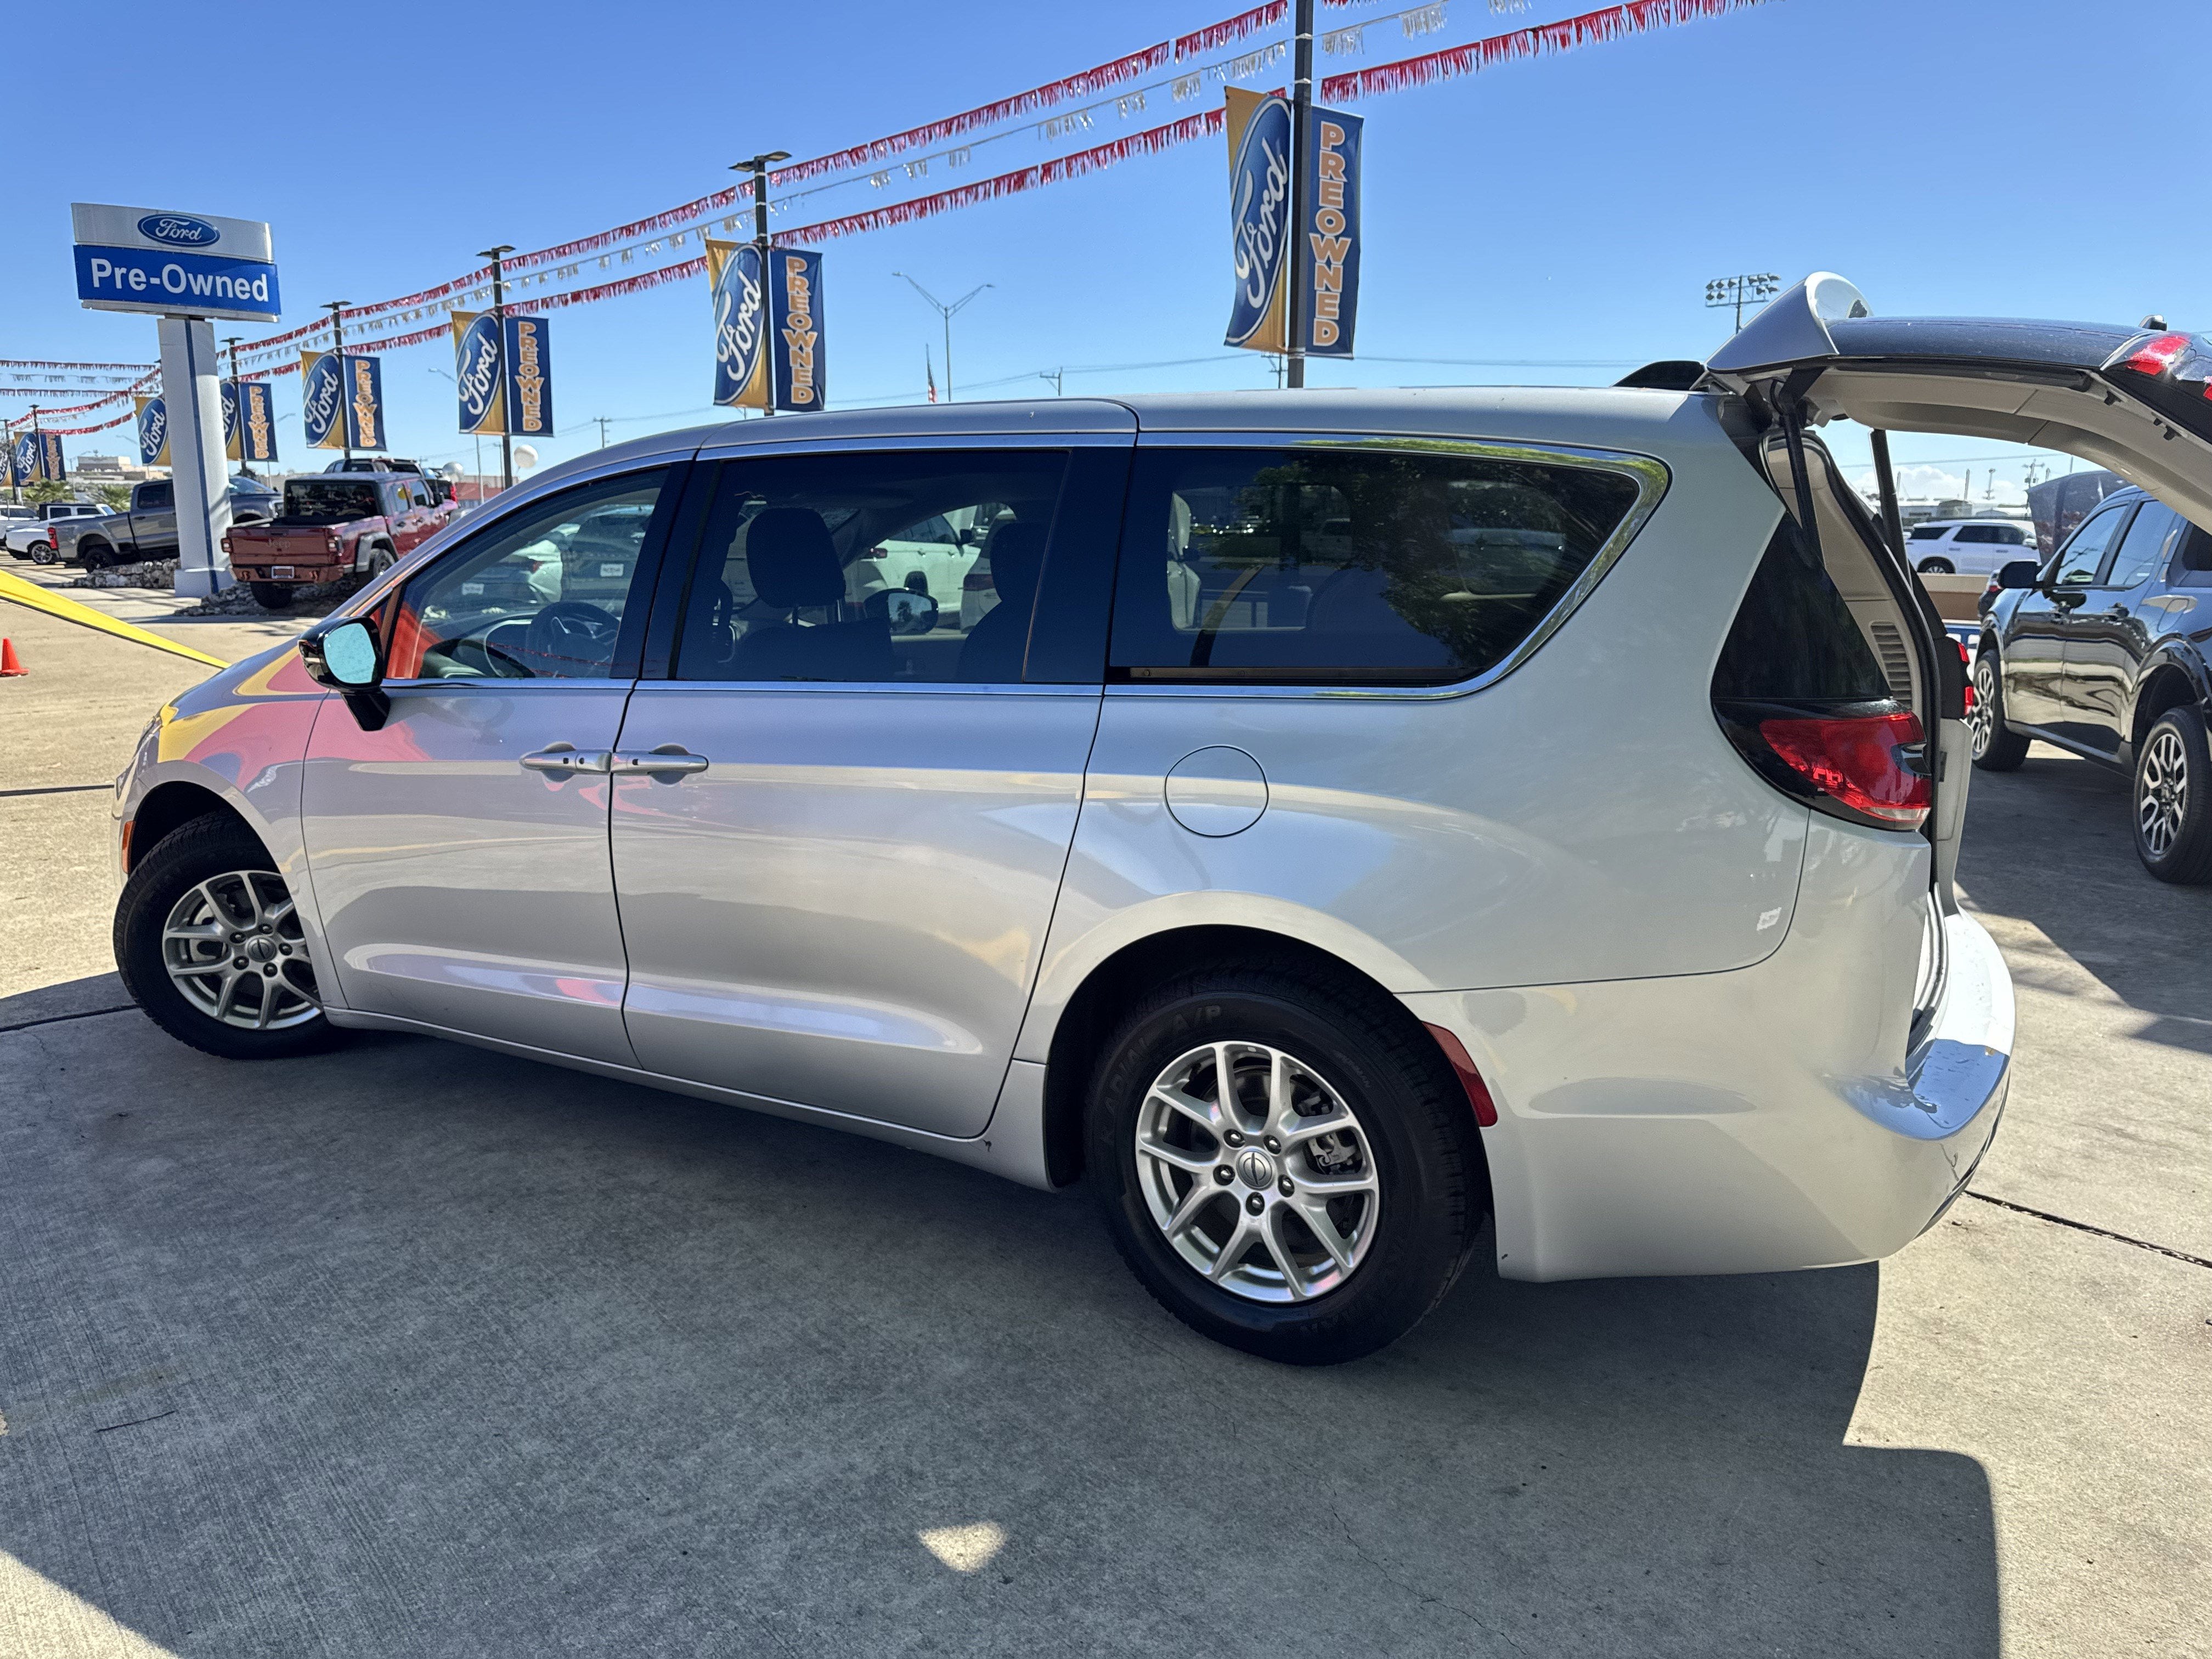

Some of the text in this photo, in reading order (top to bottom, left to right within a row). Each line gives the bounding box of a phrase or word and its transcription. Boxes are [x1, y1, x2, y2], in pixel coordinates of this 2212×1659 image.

[155, 218, 202, 241] Ford
[1234, 137, 1288, 308] Ford
[1310, 121, 1351, 347] PREOWNED
[91, 258, 269, 302] Pre-Owned
[717, 269, 761, 381] Ford
[781, 256, 818, 404] PREOWNED
[304, 369, 338, 434] Ford
[352, 360, 378, 448] PREOWNED
[459, 332, 497, 416] Ford
[515, 321, 544, 432] PREOWNED
[16, 439, 37, 474] Ford
[139, 409, 165, 456] Ford
